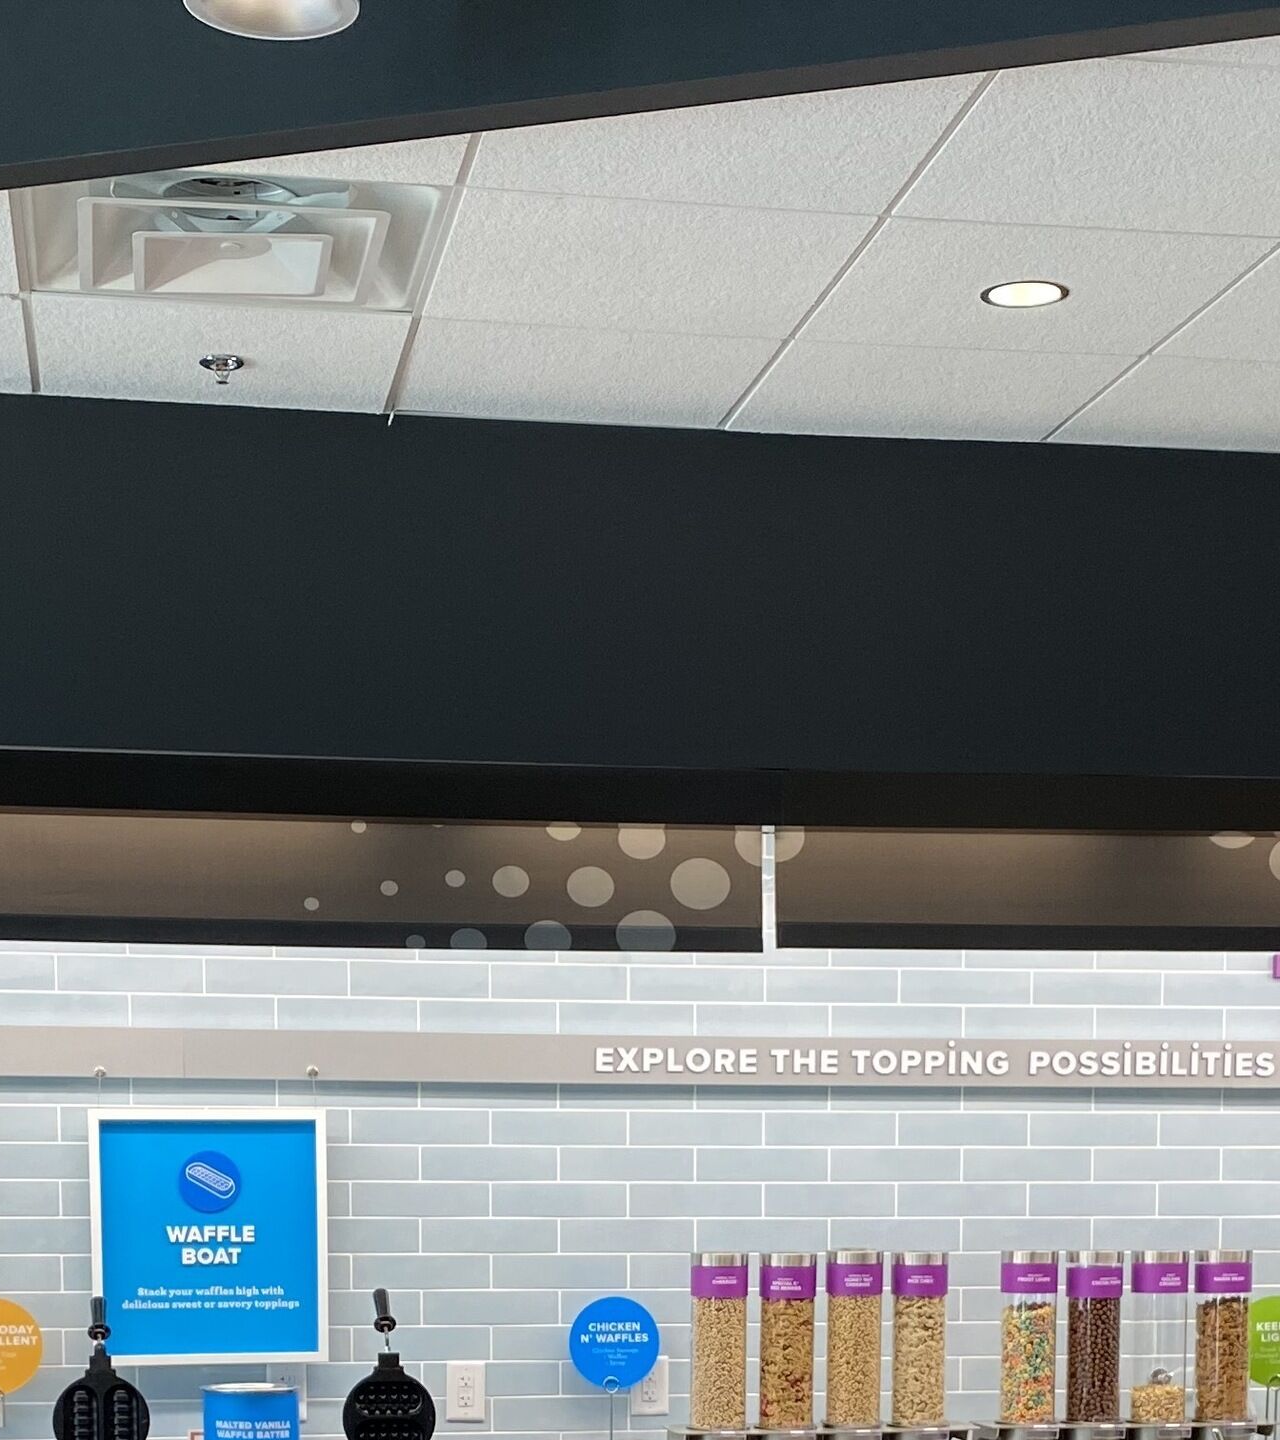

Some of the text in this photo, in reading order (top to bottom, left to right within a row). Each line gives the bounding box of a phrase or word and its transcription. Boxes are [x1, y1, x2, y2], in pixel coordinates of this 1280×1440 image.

[595, 1047, 758, 1073] EXPLORE
[770, 1049, 839, 1074] THE
[850, 1040, 1009, 1075] TOPPING
[166, 1225, 256, 1243] WAFFLE
[181, 1247, 242, 1265] BOAT
[137, 1286, 284, 1298] Stack your waffles high with
[122, 1300, 170, 1309] delicious
[172, 1300, 202, 1309] sweet
[217, 1301, 252, 1310] savory
[254, 1299, 300, 1309] toppings
[588, 1321, 640, 1332] CHICKEN
[595, 1333, 649, 1343] WAFFLES
[215, 1420, 291, 1429] MALTED VANILLA
[216, 1429, 254, 1439] WAFFLE
